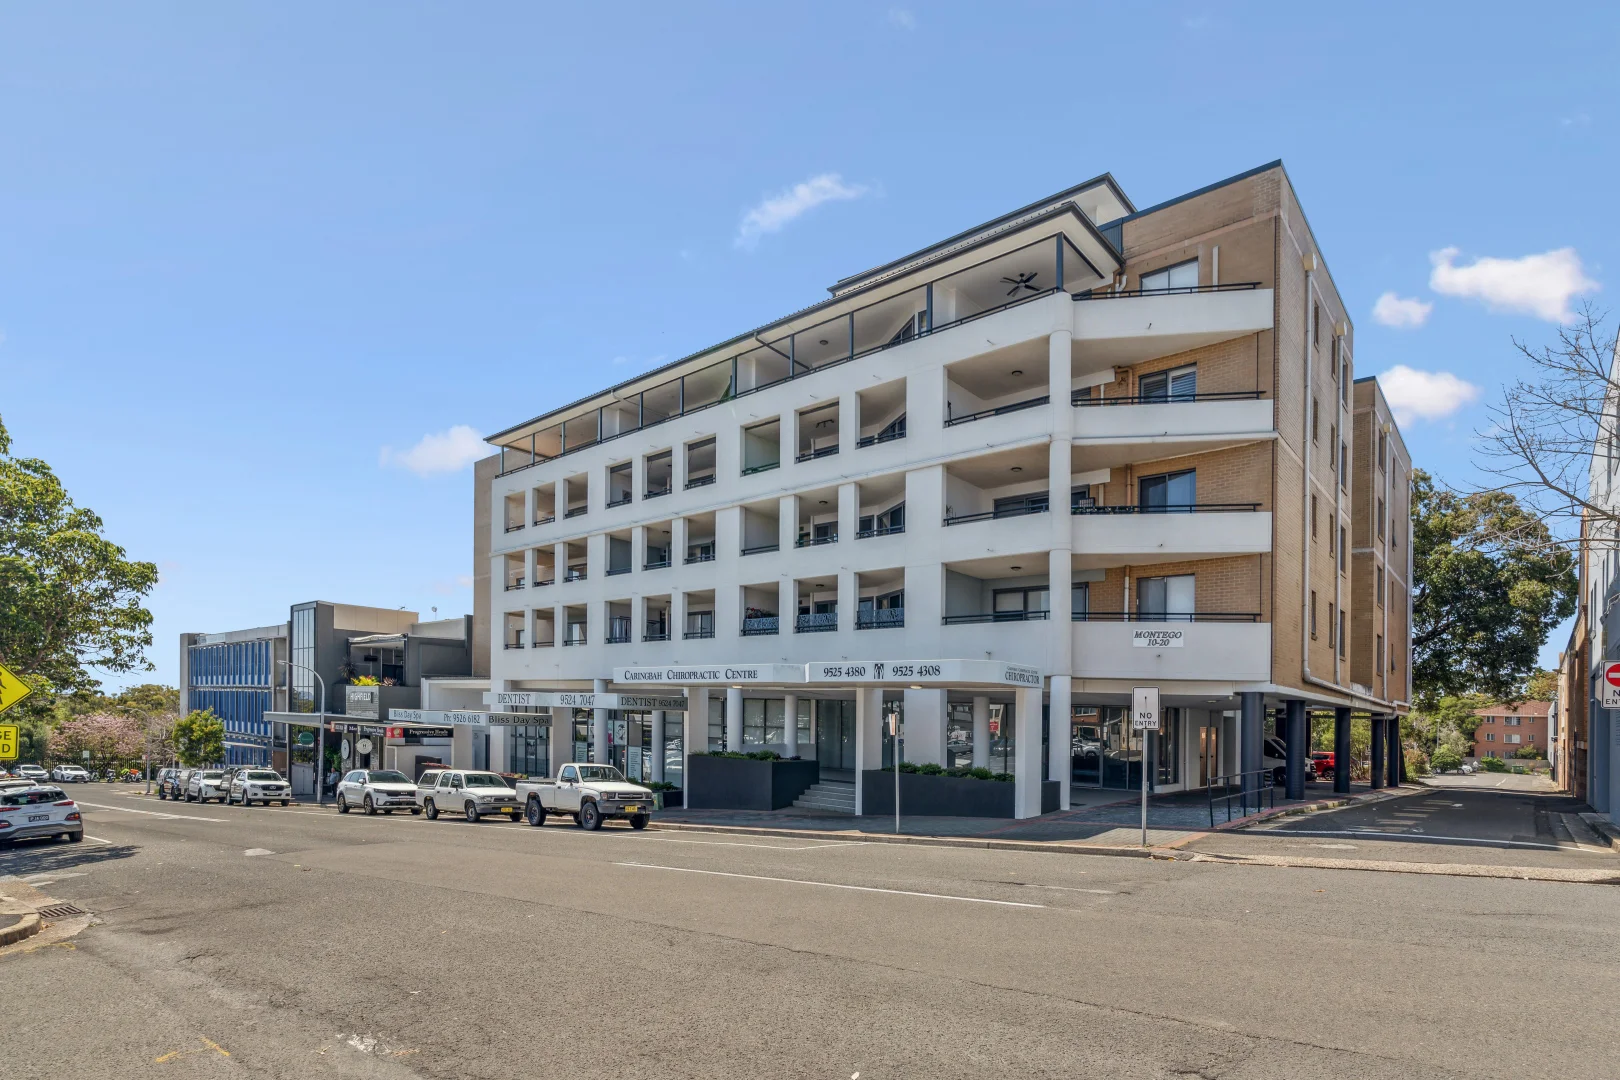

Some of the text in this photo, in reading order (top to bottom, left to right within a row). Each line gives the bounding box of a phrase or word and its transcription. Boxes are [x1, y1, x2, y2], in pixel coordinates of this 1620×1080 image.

[1134, 630, 1182, 639] MONTEGO
[823, 665, 941, 678] 9525 4380 9525 4308
[498, 694, 595, 705] DENTIST 9524 7047
[621, 696, 657, 707] DENTIST
[404, 711, 413, 720] Day
[413, 711, 422, 720] Spa
[453, 713, 466, 723] 9526
[488, 715, 549, 726] Bliss Day Spa
